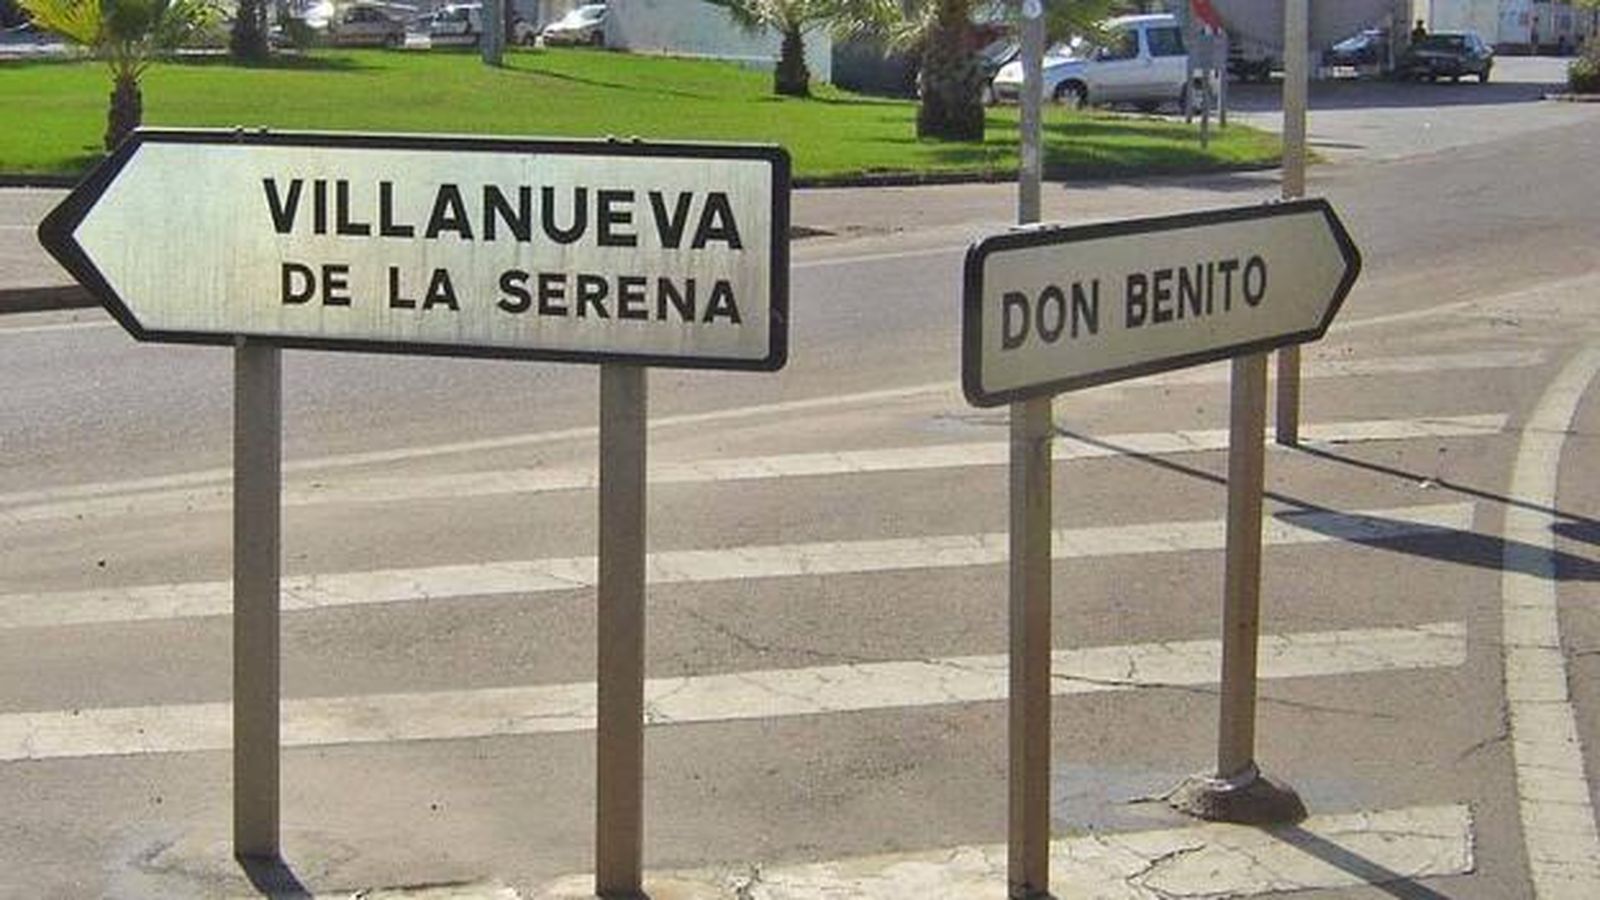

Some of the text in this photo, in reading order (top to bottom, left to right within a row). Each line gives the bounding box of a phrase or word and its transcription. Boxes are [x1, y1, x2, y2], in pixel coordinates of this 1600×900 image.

[262, 178, 744, 250] VILLANUEVA
[281, 262, 743, 325] DE LA SERENA
[1002, 254, 1268, 351] DON BENITO
